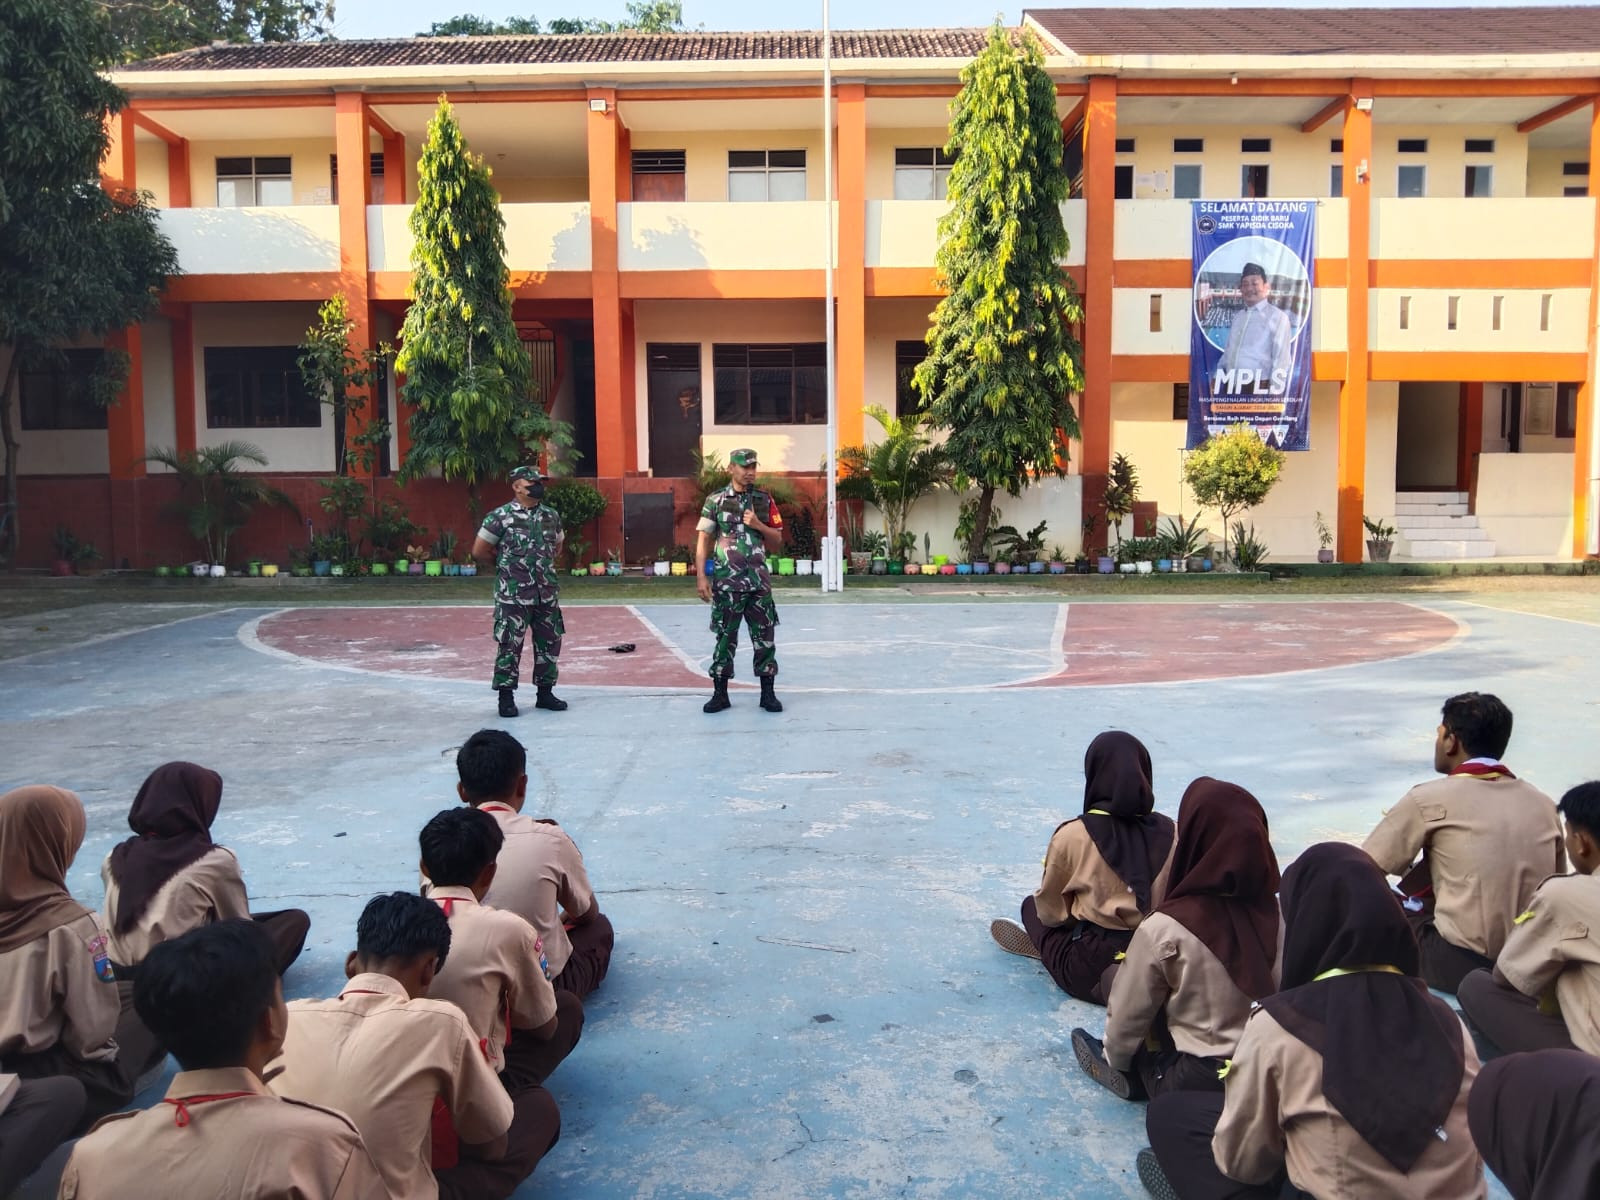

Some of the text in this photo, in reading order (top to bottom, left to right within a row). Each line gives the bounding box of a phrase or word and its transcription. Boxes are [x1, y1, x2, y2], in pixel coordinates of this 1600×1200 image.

[1200, 202, 1308, 213] SELAMAT DATANG
[1213, 368, 1288, 395] MPLS
